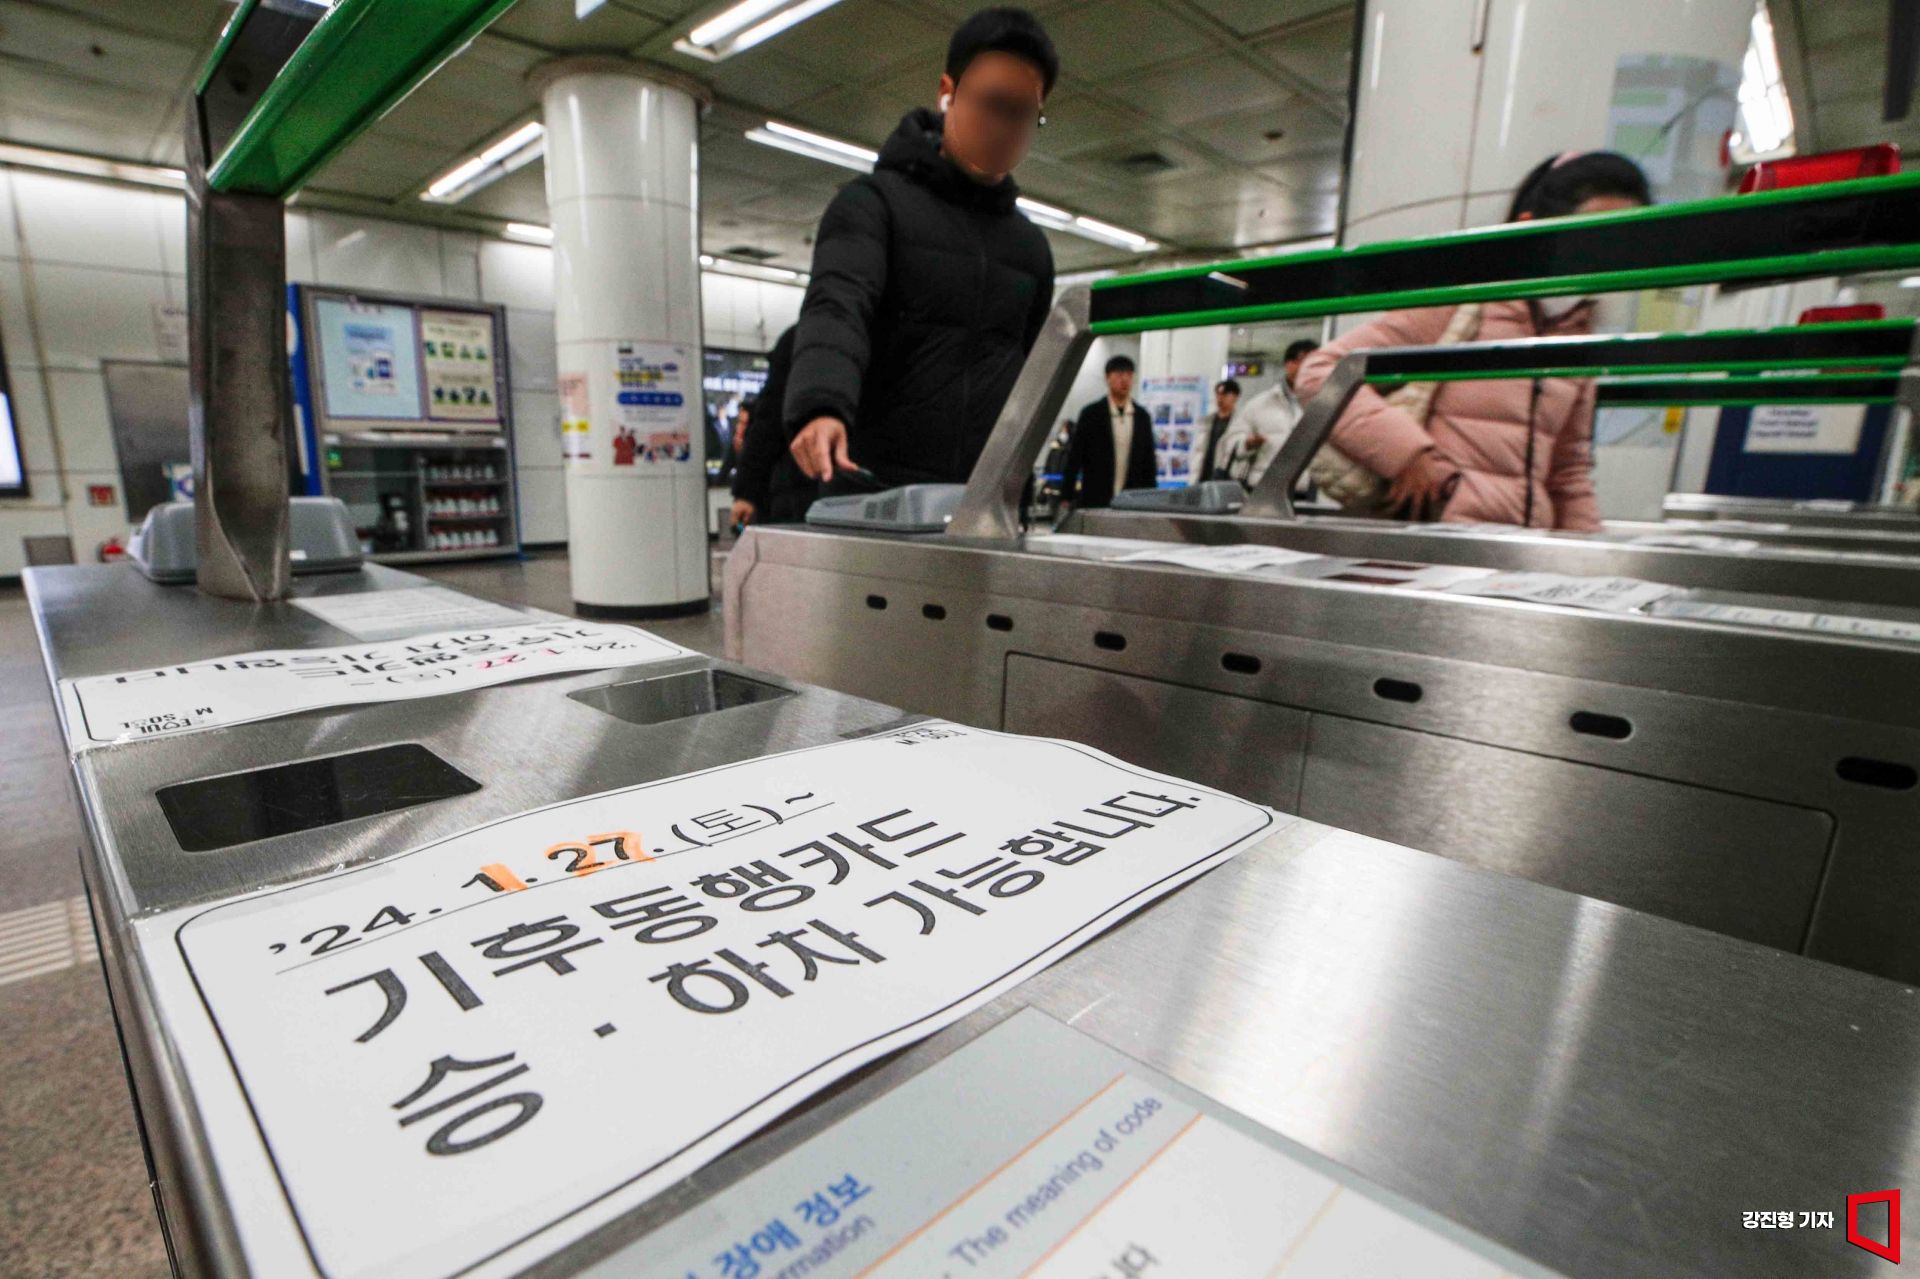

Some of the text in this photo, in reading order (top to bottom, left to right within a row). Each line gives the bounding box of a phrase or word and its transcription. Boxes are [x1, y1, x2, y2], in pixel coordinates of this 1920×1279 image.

[325, 807, 967, 1043] 기후동행카드
[648, 916, 887, 1014] 하차
[863, 790, 1202, 936] 가능합니다.
[793, 1172, 874, 1228] 정보
[947, 1224, 1009, 1268] The
[1004, 1150, 1103, 1230] meaning
[1114, 1097, 1164, 1136] code
